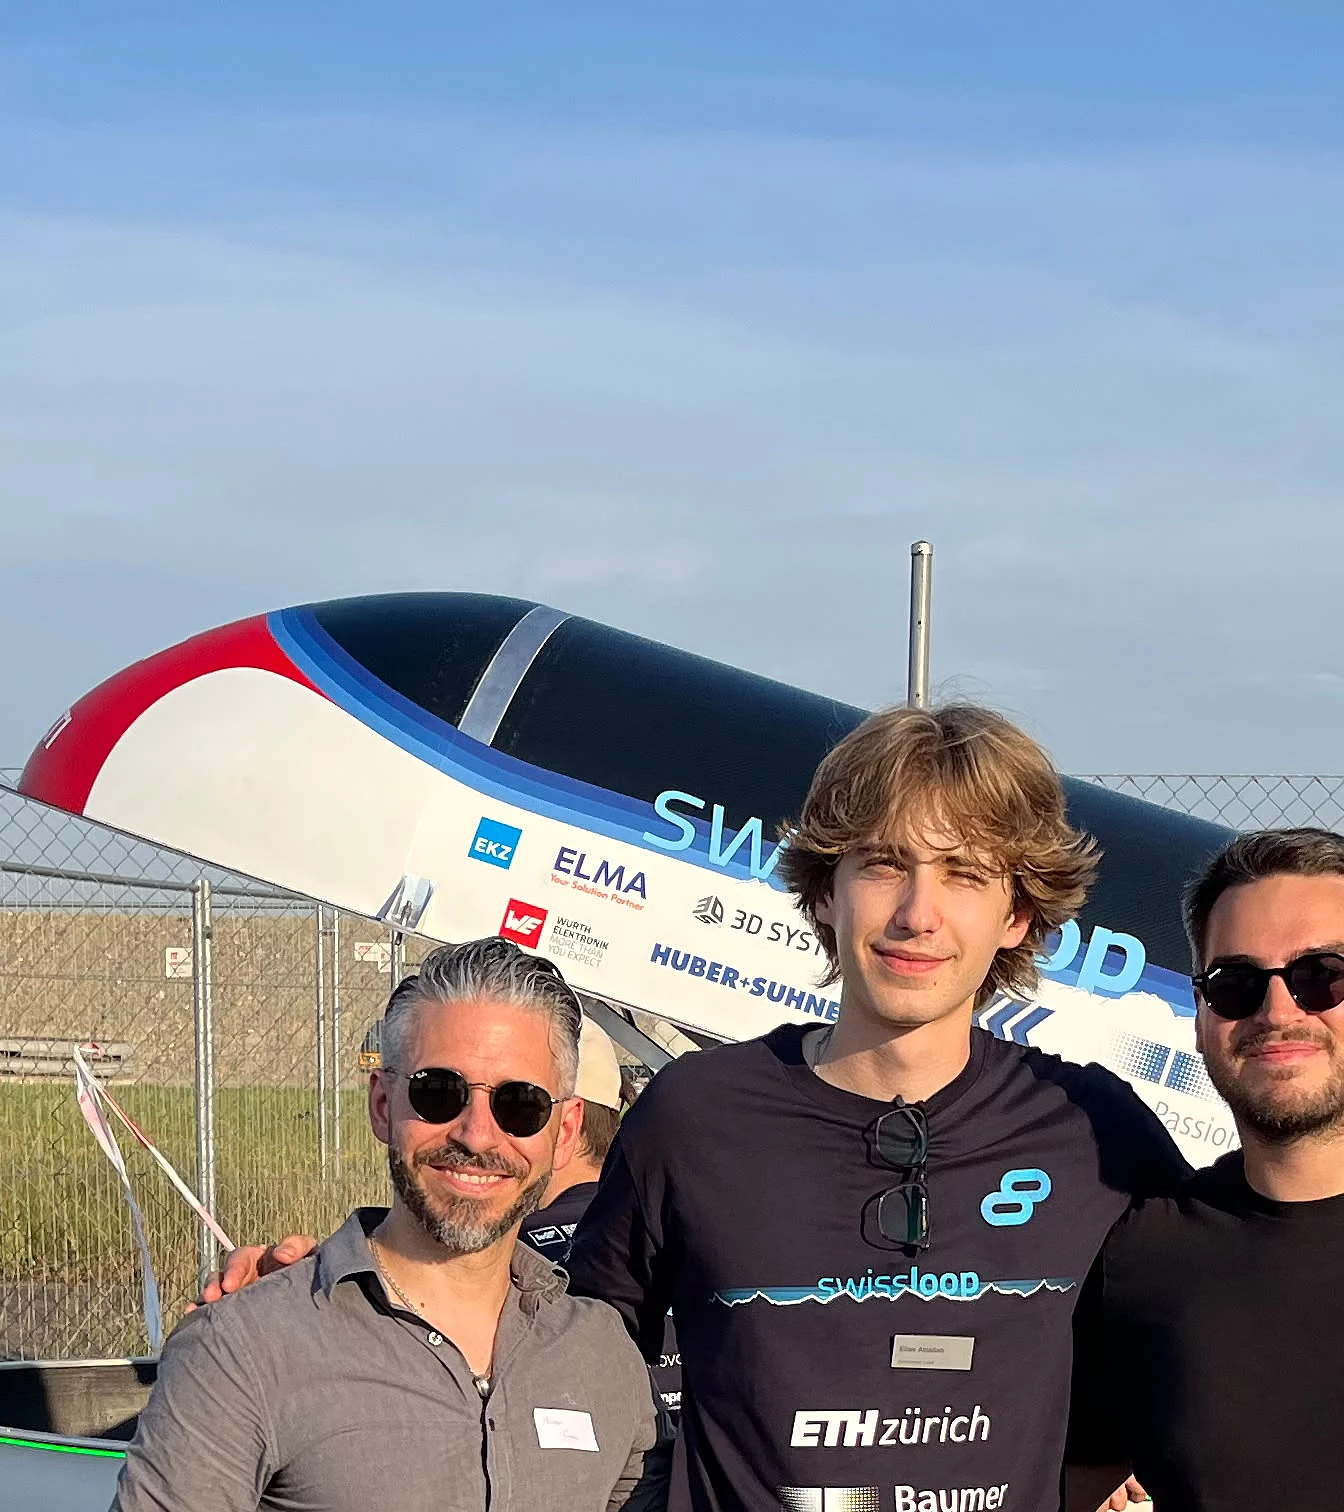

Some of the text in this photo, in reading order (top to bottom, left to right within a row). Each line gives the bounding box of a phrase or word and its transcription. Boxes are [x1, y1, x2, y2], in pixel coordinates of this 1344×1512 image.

[475, 837, 512, 861] EKZ
[553, 846, 647, 900] ELMA
[550, 873, 644, 911] Your Solution Partner
[730, 909, 763, 935] 3D
[548, 944, 602, 968] YOU EXPECT
[550, 934, 603, 959] MORE THAN
[818, 1266, 980, 1299] swissloop
